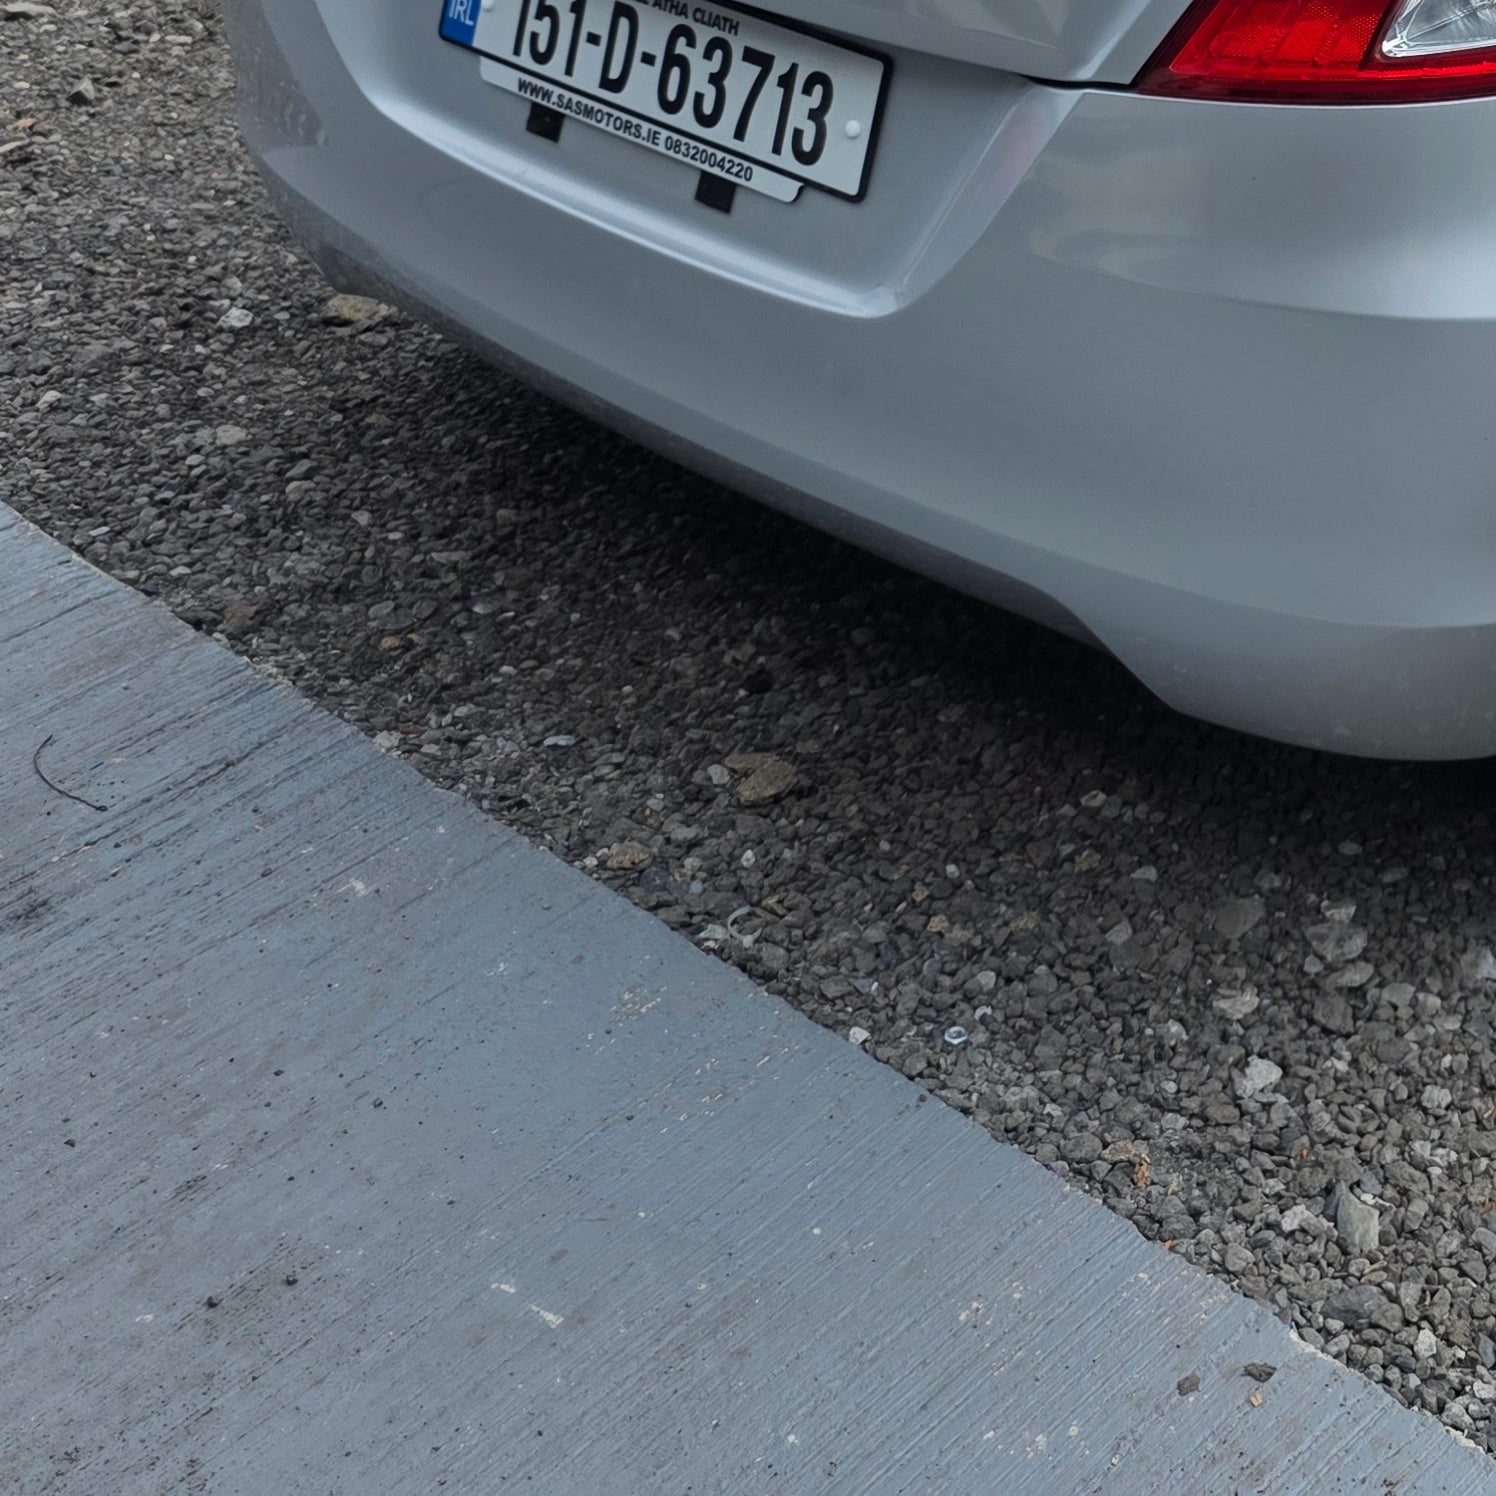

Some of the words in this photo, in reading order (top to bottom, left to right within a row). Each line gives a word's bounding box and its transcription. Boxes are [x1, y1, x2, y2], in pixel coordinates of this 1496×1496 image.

[692, 7, 740, 37] CLIATH
[517, 77, 661, 147] WWW.SASMOTORS.IE
[664, 135, 754, 183] 0832004220
